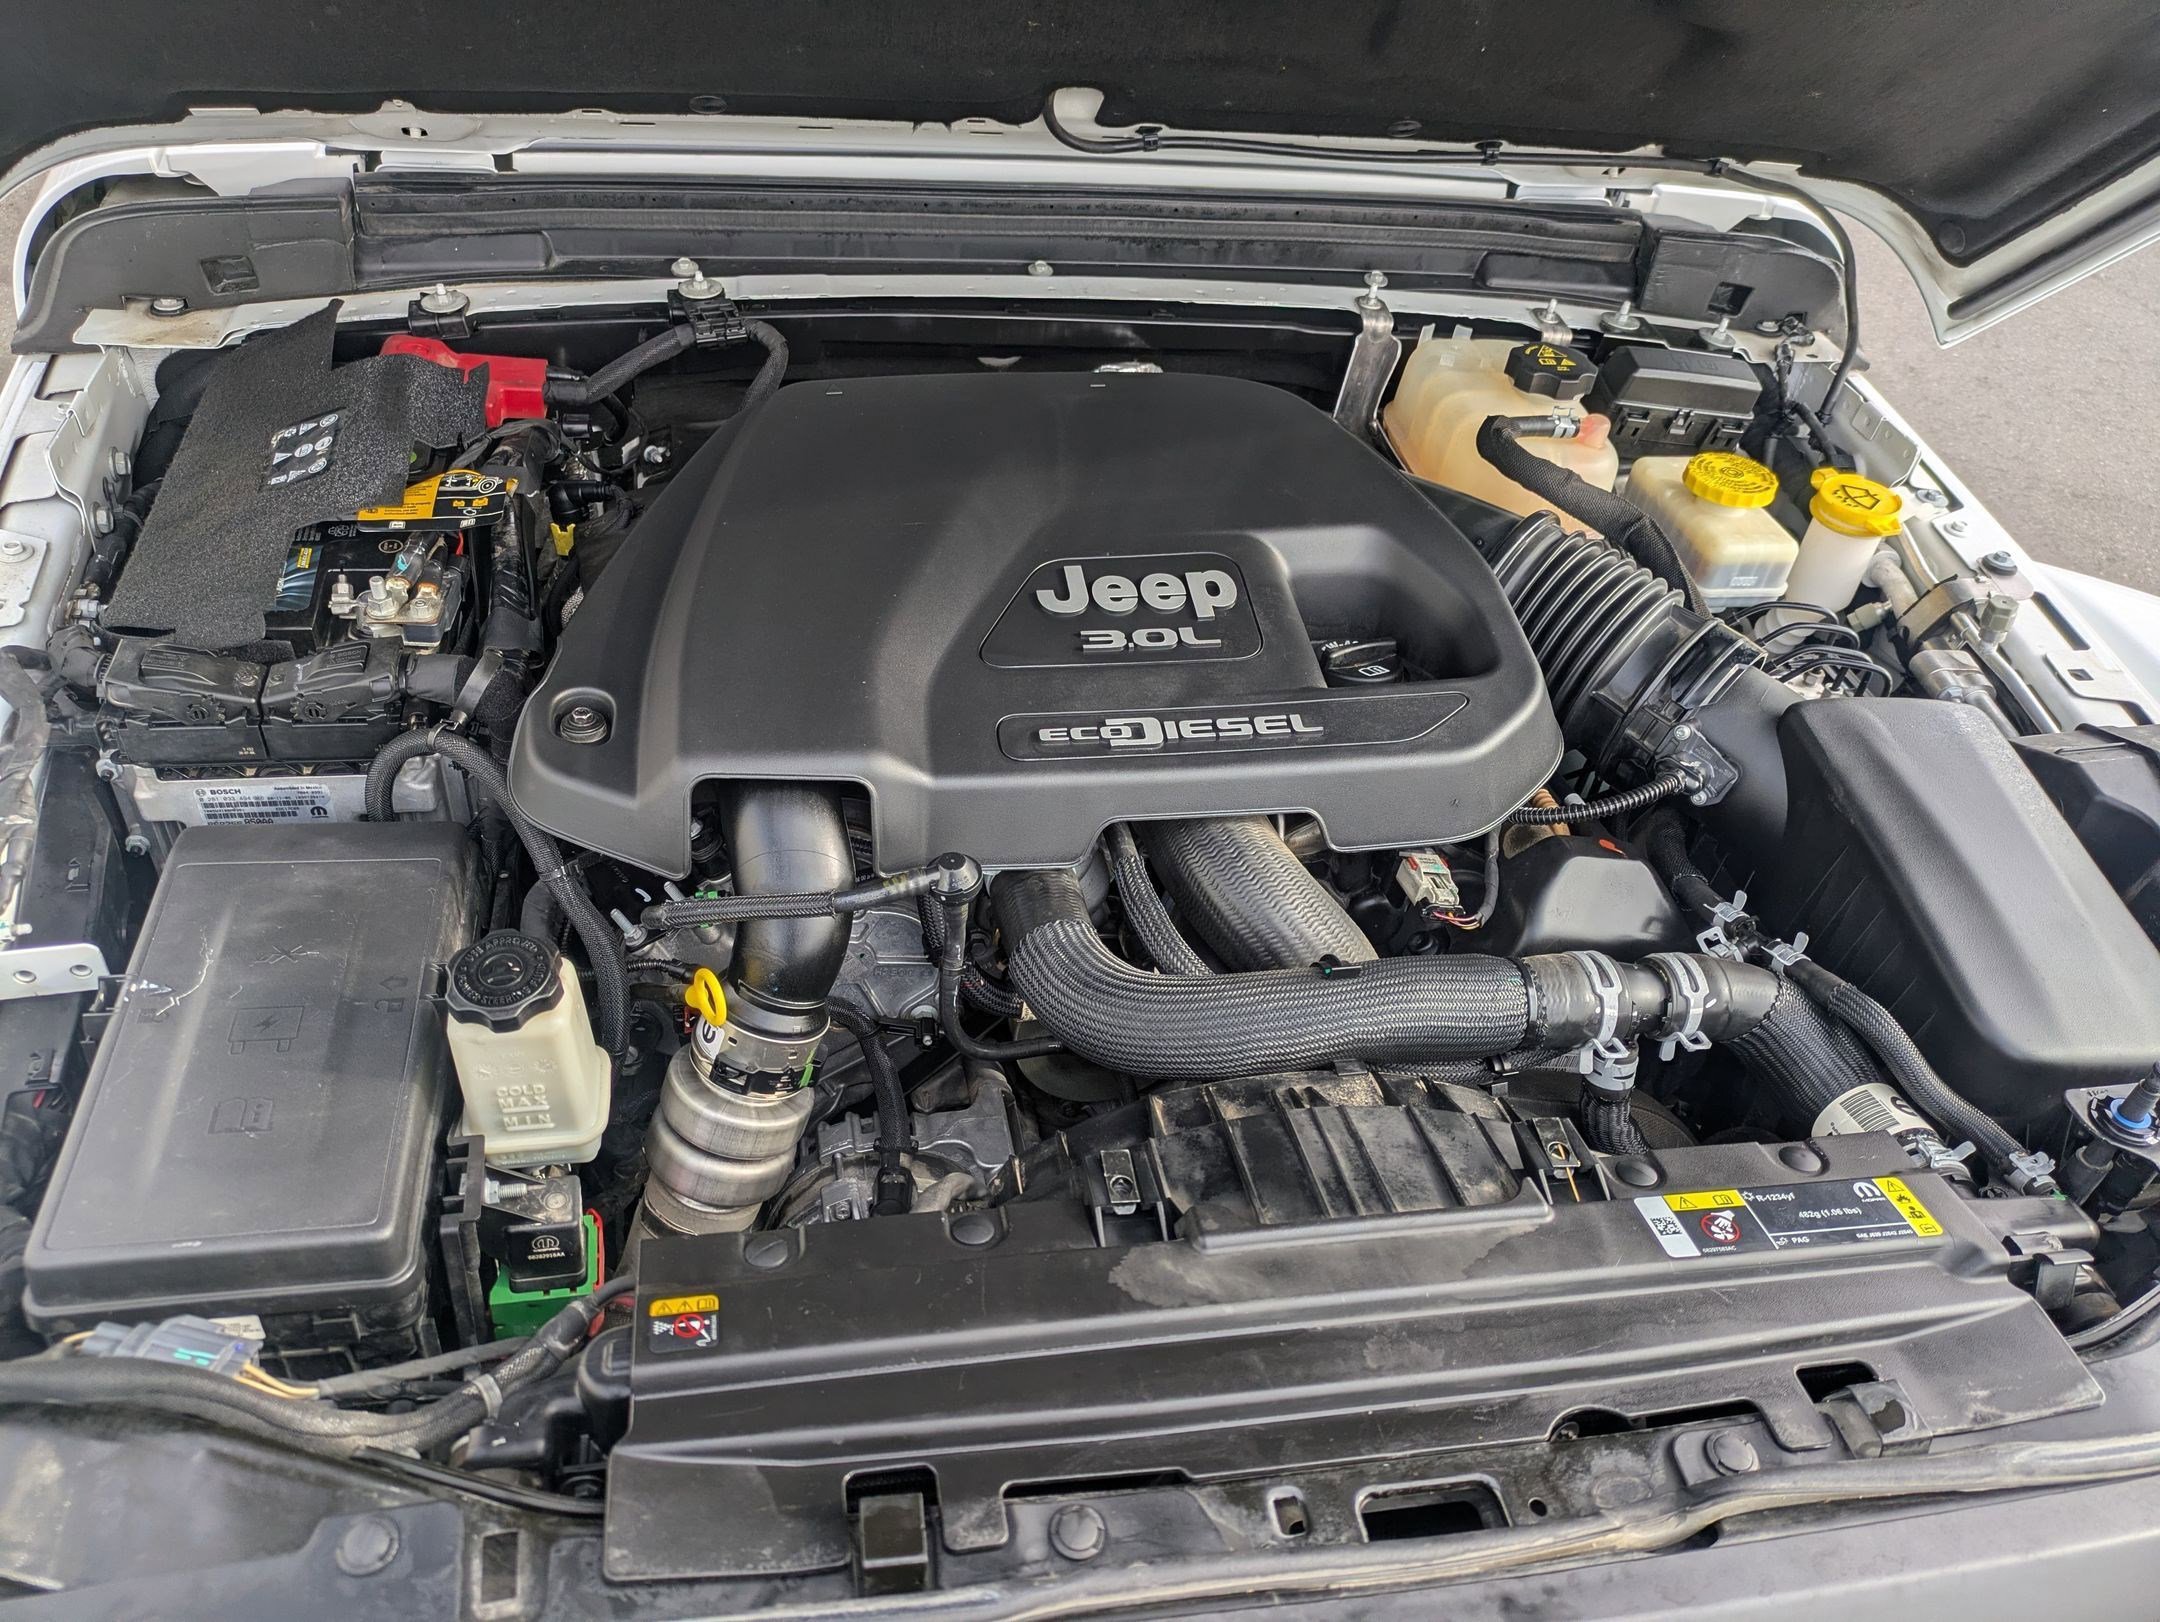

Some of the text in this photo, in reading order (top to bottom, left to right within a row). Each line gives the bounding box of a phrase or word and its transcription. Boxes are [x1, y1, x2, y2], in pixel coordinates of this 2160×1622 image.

[1036, 565, 1238, 621] Jeep
[1080, 626, 1222, 653] 3.0L
[1038, 713, 1324, 750] ECODIESEL
[496, 1084, 546, 1097] COLD
[498, 1096, 548, 1110] MAX
[503, 1114, 553, 1127] MIN
[1756, 1192, 1795, 1202] R-1234yf
[1821, 1207, 1843, 1218] (1.06
[1844, 1206, 1862, 1216] lbs)
[1791, 1236, 1810, 1244] PAG
